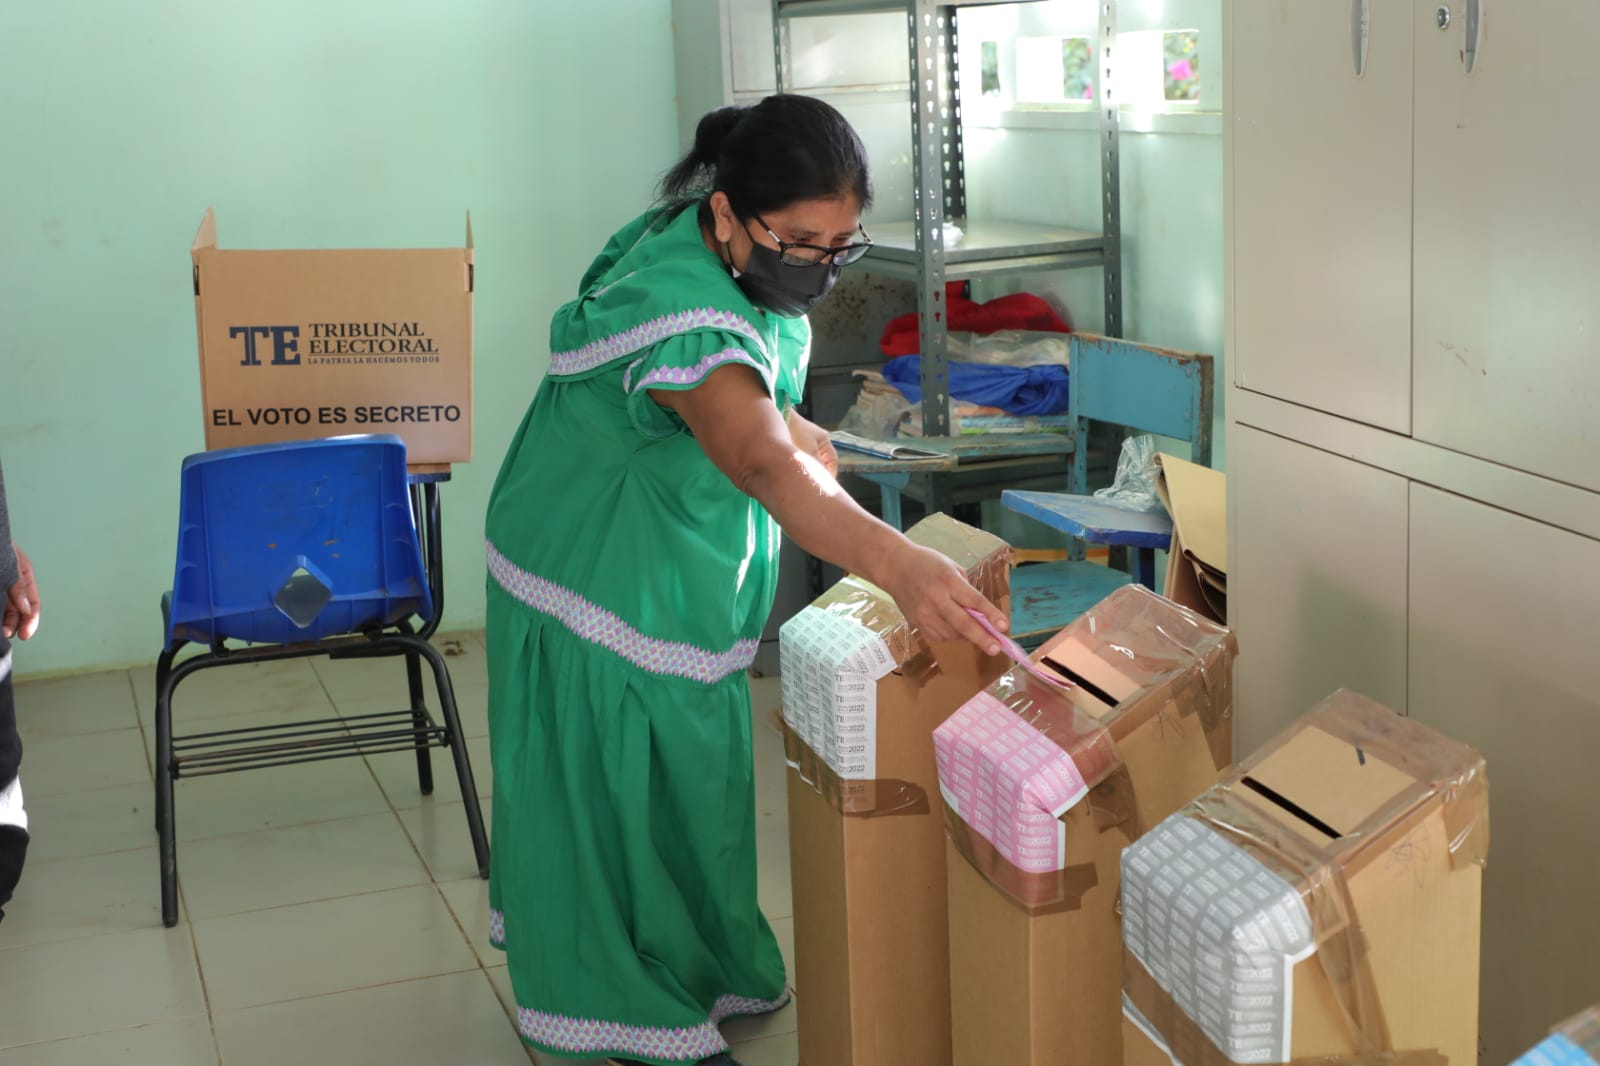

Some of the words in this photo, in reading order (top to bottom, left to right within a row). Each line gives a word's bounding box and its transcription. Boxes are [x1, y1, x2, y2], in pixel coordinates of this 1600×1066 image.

[308, 322, 424, 337] TRIBUNAL
[229, 326, 300, 365] TE
[309, 338, 439, 354] ELECTORAL
[212, 409, 242, 426] EL
[247, 408, 311, 425] VOTO
[318, 407, 347, 424] ES
[354, 405, 461, 423] SECRETO
